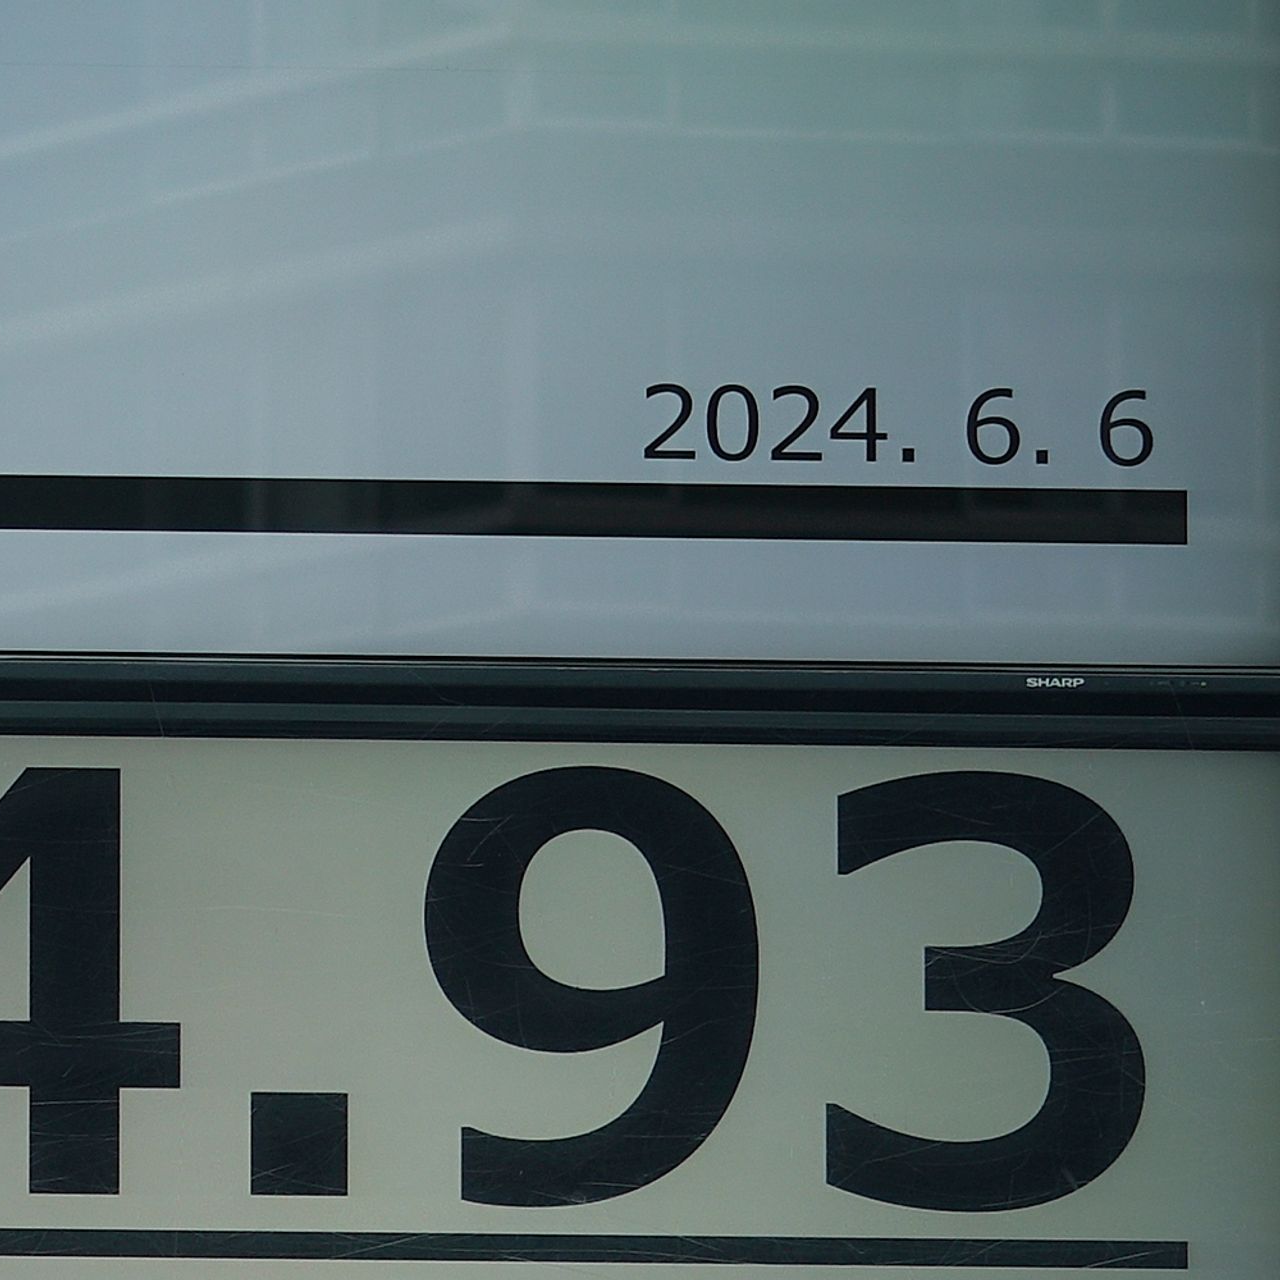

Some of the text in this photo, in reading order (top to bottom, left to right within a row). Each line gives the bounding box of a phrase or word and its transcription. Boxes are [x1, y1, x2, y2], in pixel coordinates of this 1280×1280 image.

[643, 383, 1154, 468] 2024. 6. 6
[1025, 677, 1085, 689] SHARP
